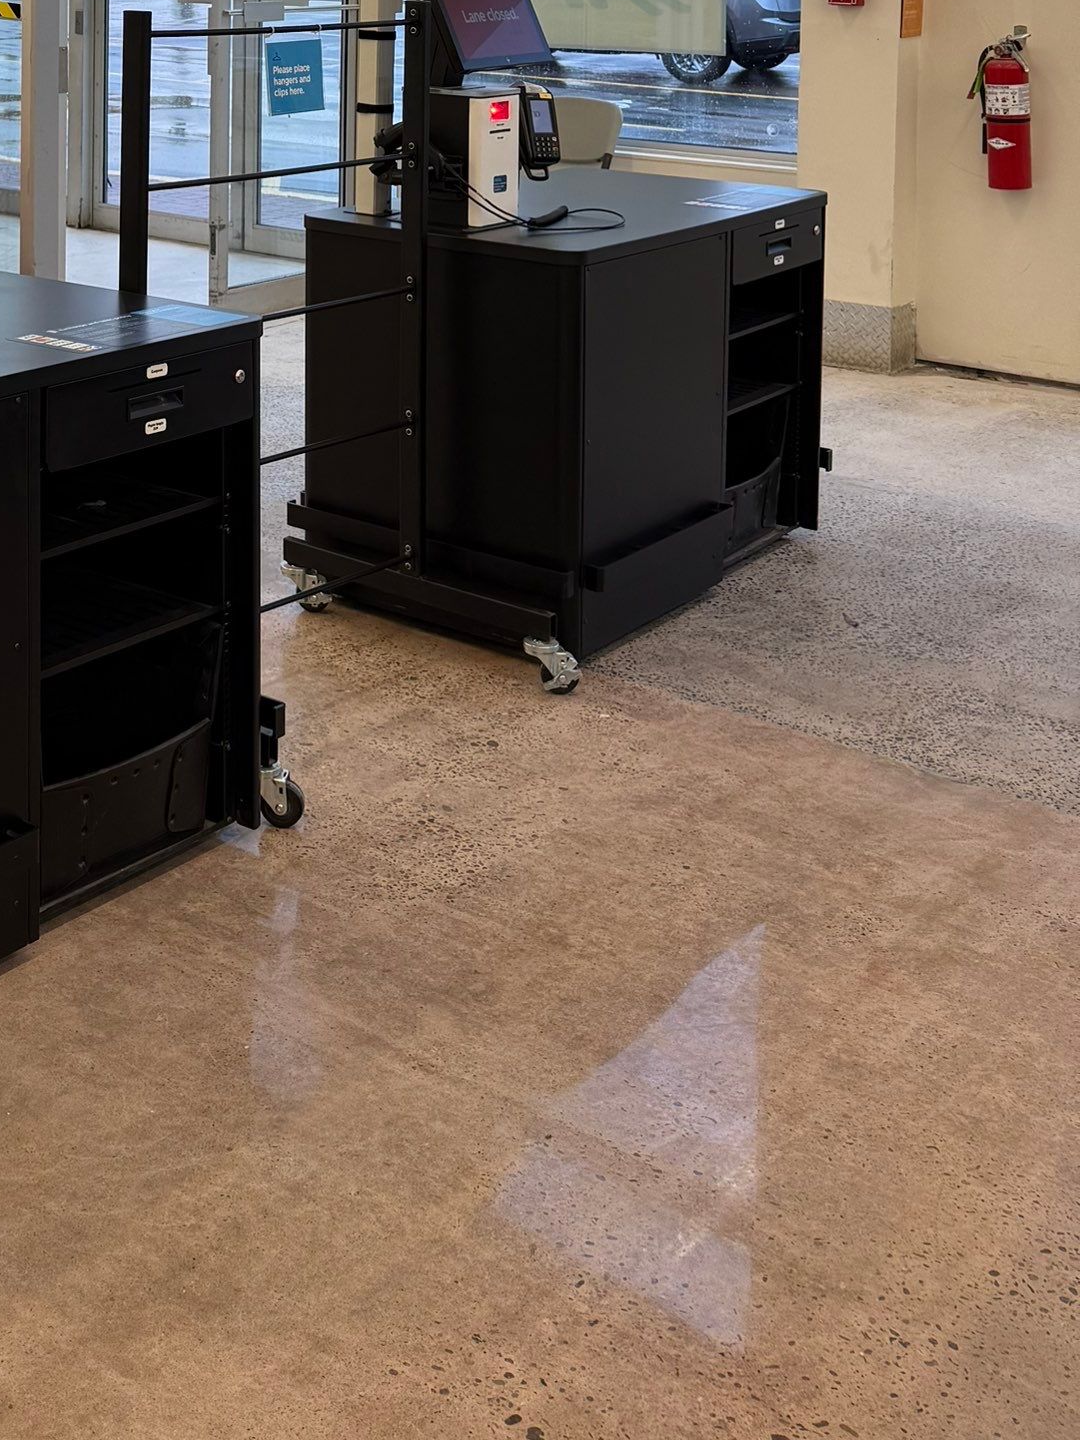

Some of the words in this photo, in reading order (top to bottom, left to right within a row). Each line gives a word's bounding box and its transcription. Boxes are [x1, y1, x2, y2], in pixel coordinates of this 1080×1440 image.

[461, 9, 486, 24] Lane
[486, 7, 520, 22] closed.
[273, 65, 293, 74] Please
[293, 64, 310, 74] place
[273, 77, 299, 86] hangers
[299, 74, 311, 83] and
[274, 88, 289, 97] clips
[289, 87, 305, 96] here.
